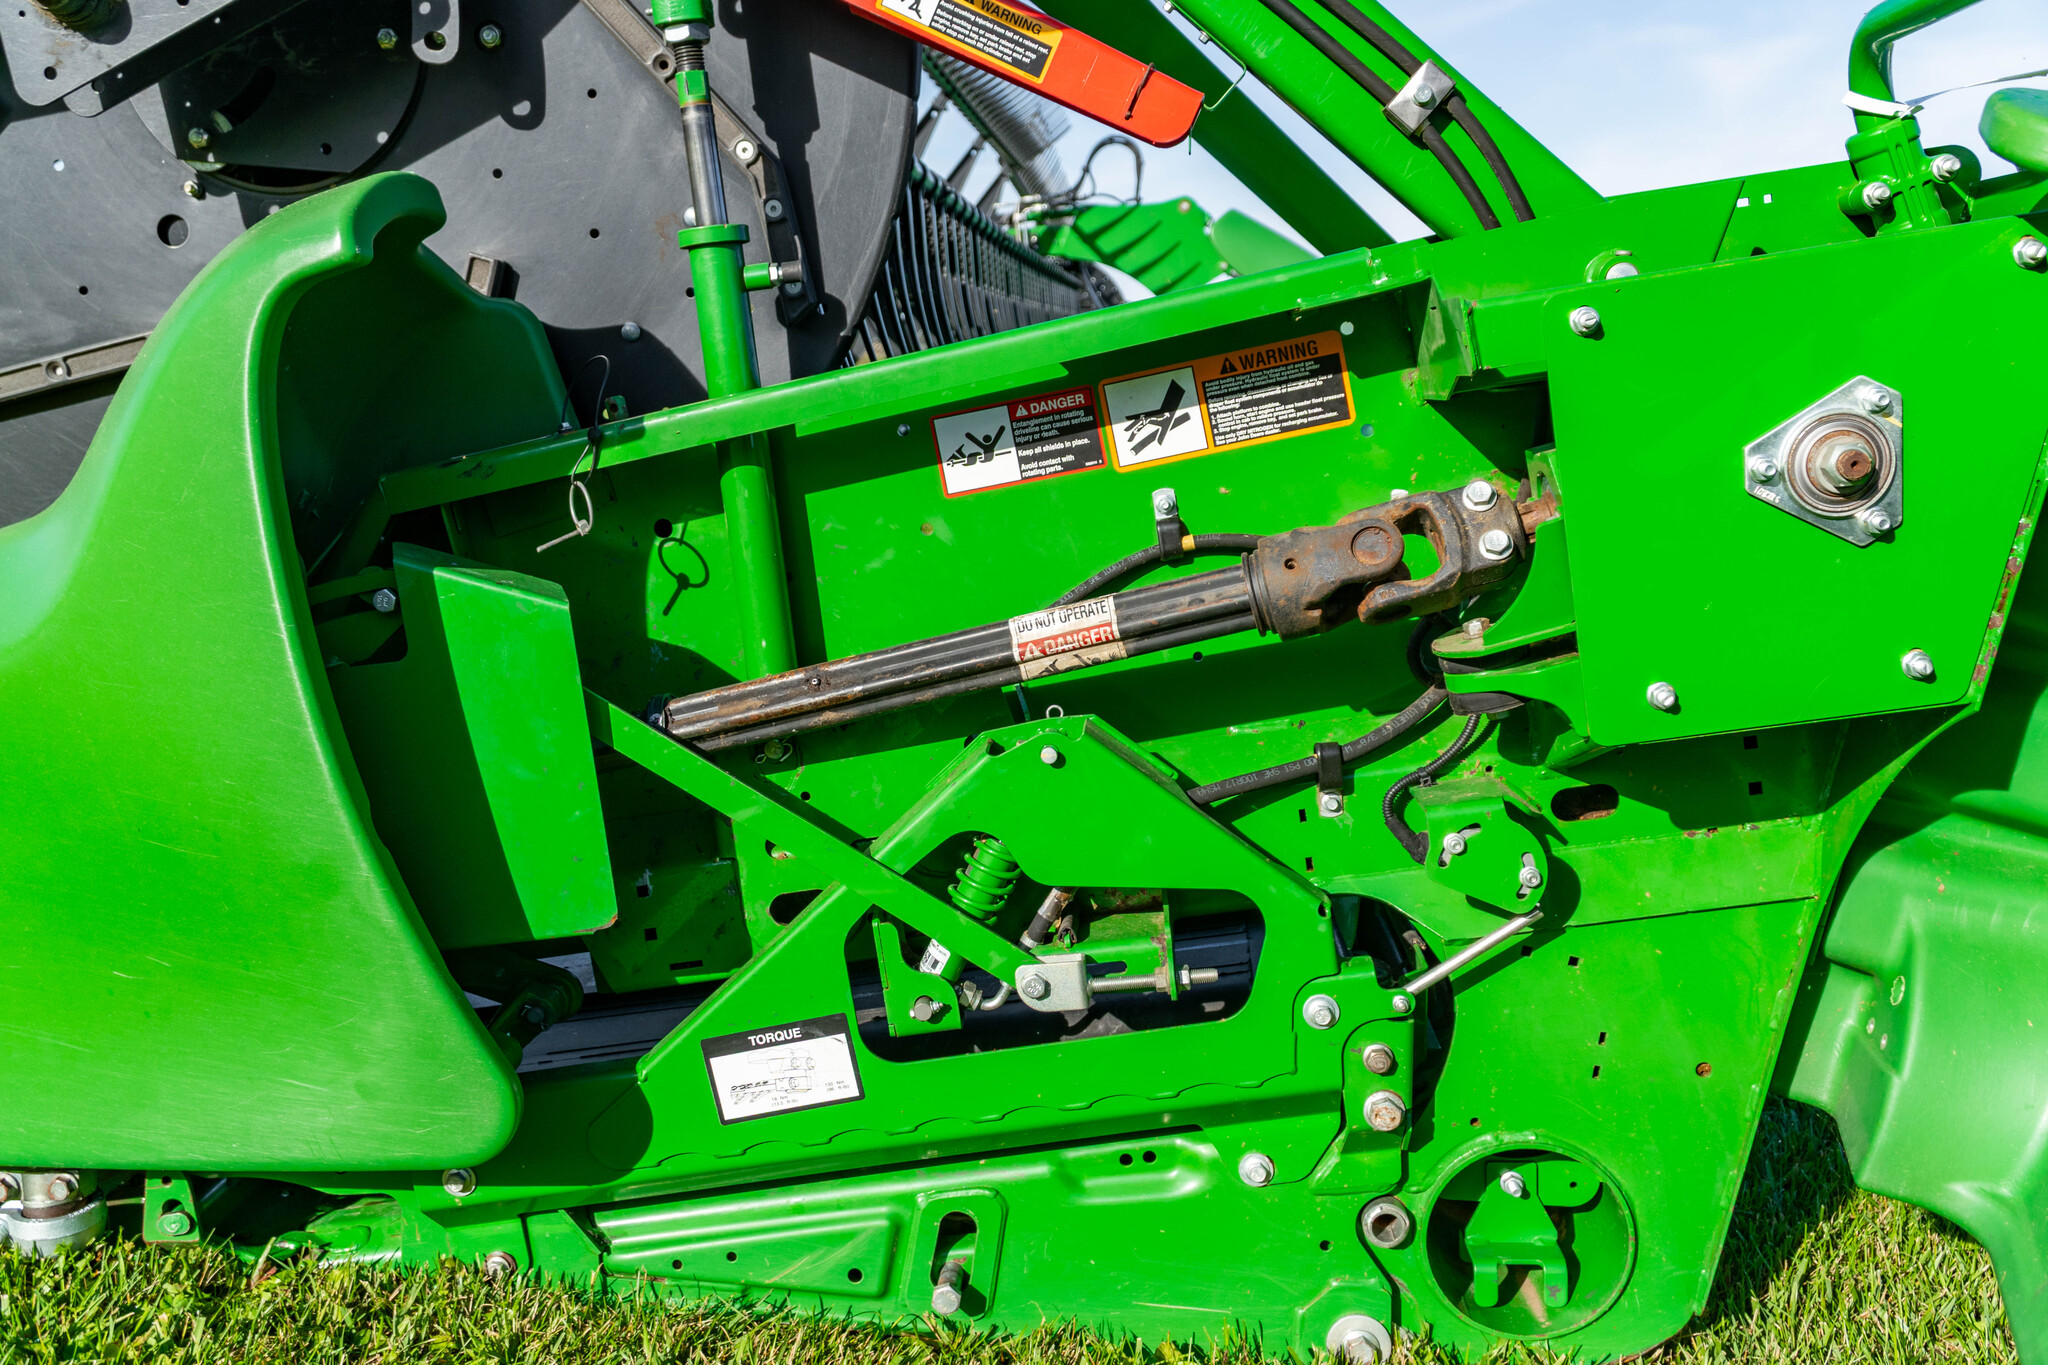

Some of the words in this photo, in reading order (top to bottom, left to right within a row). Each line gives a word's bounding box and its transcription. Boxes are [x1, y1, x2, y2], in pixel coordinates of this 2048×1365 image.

[940, 0, 953, 9] Avoid
[954, 7, 974, 20] crushing
[975, 16, 993, 28] injuries
[994, 25, 1004, 33] from
[1023, 38, 1037, 48] raised
[981, 0, 1042, 35] WARNING
[1239, 340, 1318, 370] WARNING
[1029, 393, 1085, 413] DANGER
[1012, 415, 1053, 429] Entanglement
[1060, 409, 1084, 419] rotating
[1013, 426, 1039, 435] driveline
[1052, 420, 1070, 428] cause
[1070, 414, 1093, 423] serious
[1015, 434, 1032, 443] injury
[1041, 429, 1059, 437] death.
[1017, 447, 1033, 457] Keep
[1042, 441, 1064, 451] shields
[1071, 436, 1090, 447] place.
[1020, 461, 1037, 470] Avoid
[1038, 457, 1061, 466] contact
[1061, 454, 1074, 462] with
[1021, 467, 1045, 478] rotating
[1045, 464, 1063, 473] parts.
[1016, 619, 1033, 633] DO
[1034, 611, 1056, 629] NOT
[1057, 599, 1107, 623] OPERATE
[1043, 625, 1114, 654] DANGER
[748, 1028, 802, 1046] TORQUE
